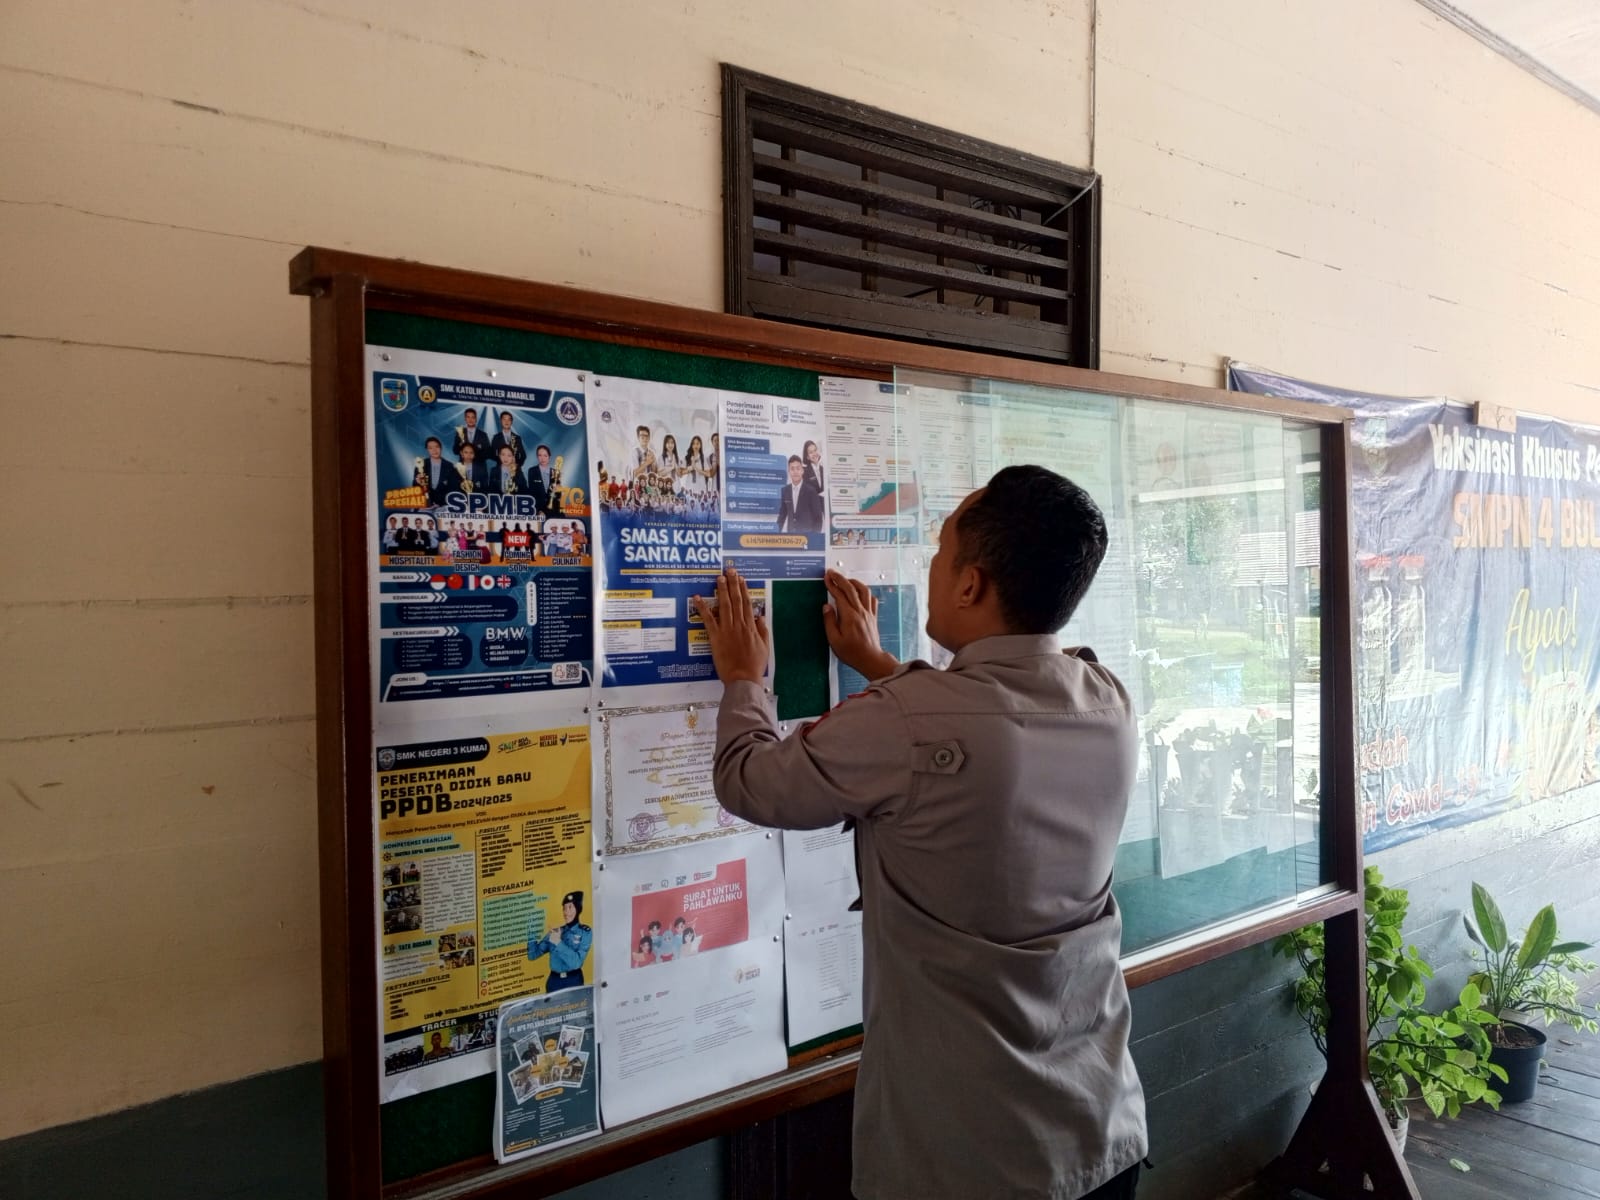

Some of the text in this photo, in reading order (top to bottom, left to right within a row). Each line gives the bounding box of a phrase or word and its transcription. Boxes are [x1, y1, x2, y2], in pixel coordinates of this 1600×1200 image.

[440, 384, 455, 393] SMK
[456, 386, 482, 395] KATOLIK
[484, 389, 505, 398] MATER
[507, 390, 536, 401] AMABILIS
[726, 400, 764, 410] Penerimaan
[1429, 423, 1516, 477] Vaksinasi
[1521, 436, 1581, 480] Khusus
[386, 487, 422, 498] PROMO
[445, 491, 537, 516] SPMB
[1454, 491, 1532, 549] SMPN
[1538, 497, 1553, 548] 4
[508, 534, 527, 543] NEW
[620, 527, 669, 545] SMAS
[389, 556, 435, 565] HOSPITALITY
[452, 550, 482, 559] FASHION
[504, 550, 531, 559] COMING
[552, 557, 582, 565] CULINARY
[624, 545, 681, 563] SANTA
[454, 563, 480, 572] DESIGN
[508, 563, 528, 572] SOON
[485, 627, 526, 641] BMW
[1505, 587, 1578, 673] Ayoo!
[395, 744, 488, 762] SMK NEGERI 3 KUMAI
[381, 766, 476, 786] PENERIMAAN
[381, 771, 532, 799] PESERTA DIDIK BARU
[381, 793, 513, 820] PPDB 2024/2025
[383, 835, 452, 850] KOMPETENSI KEAHLIAN
[482, 880, 535, 895] PERSYARATAN
[683, 883, 741, 904] SURAT UNTUK
[683, 891, 742, 912] PAHLAWANKU
[421, 1018, 458, 1033] TRACER
